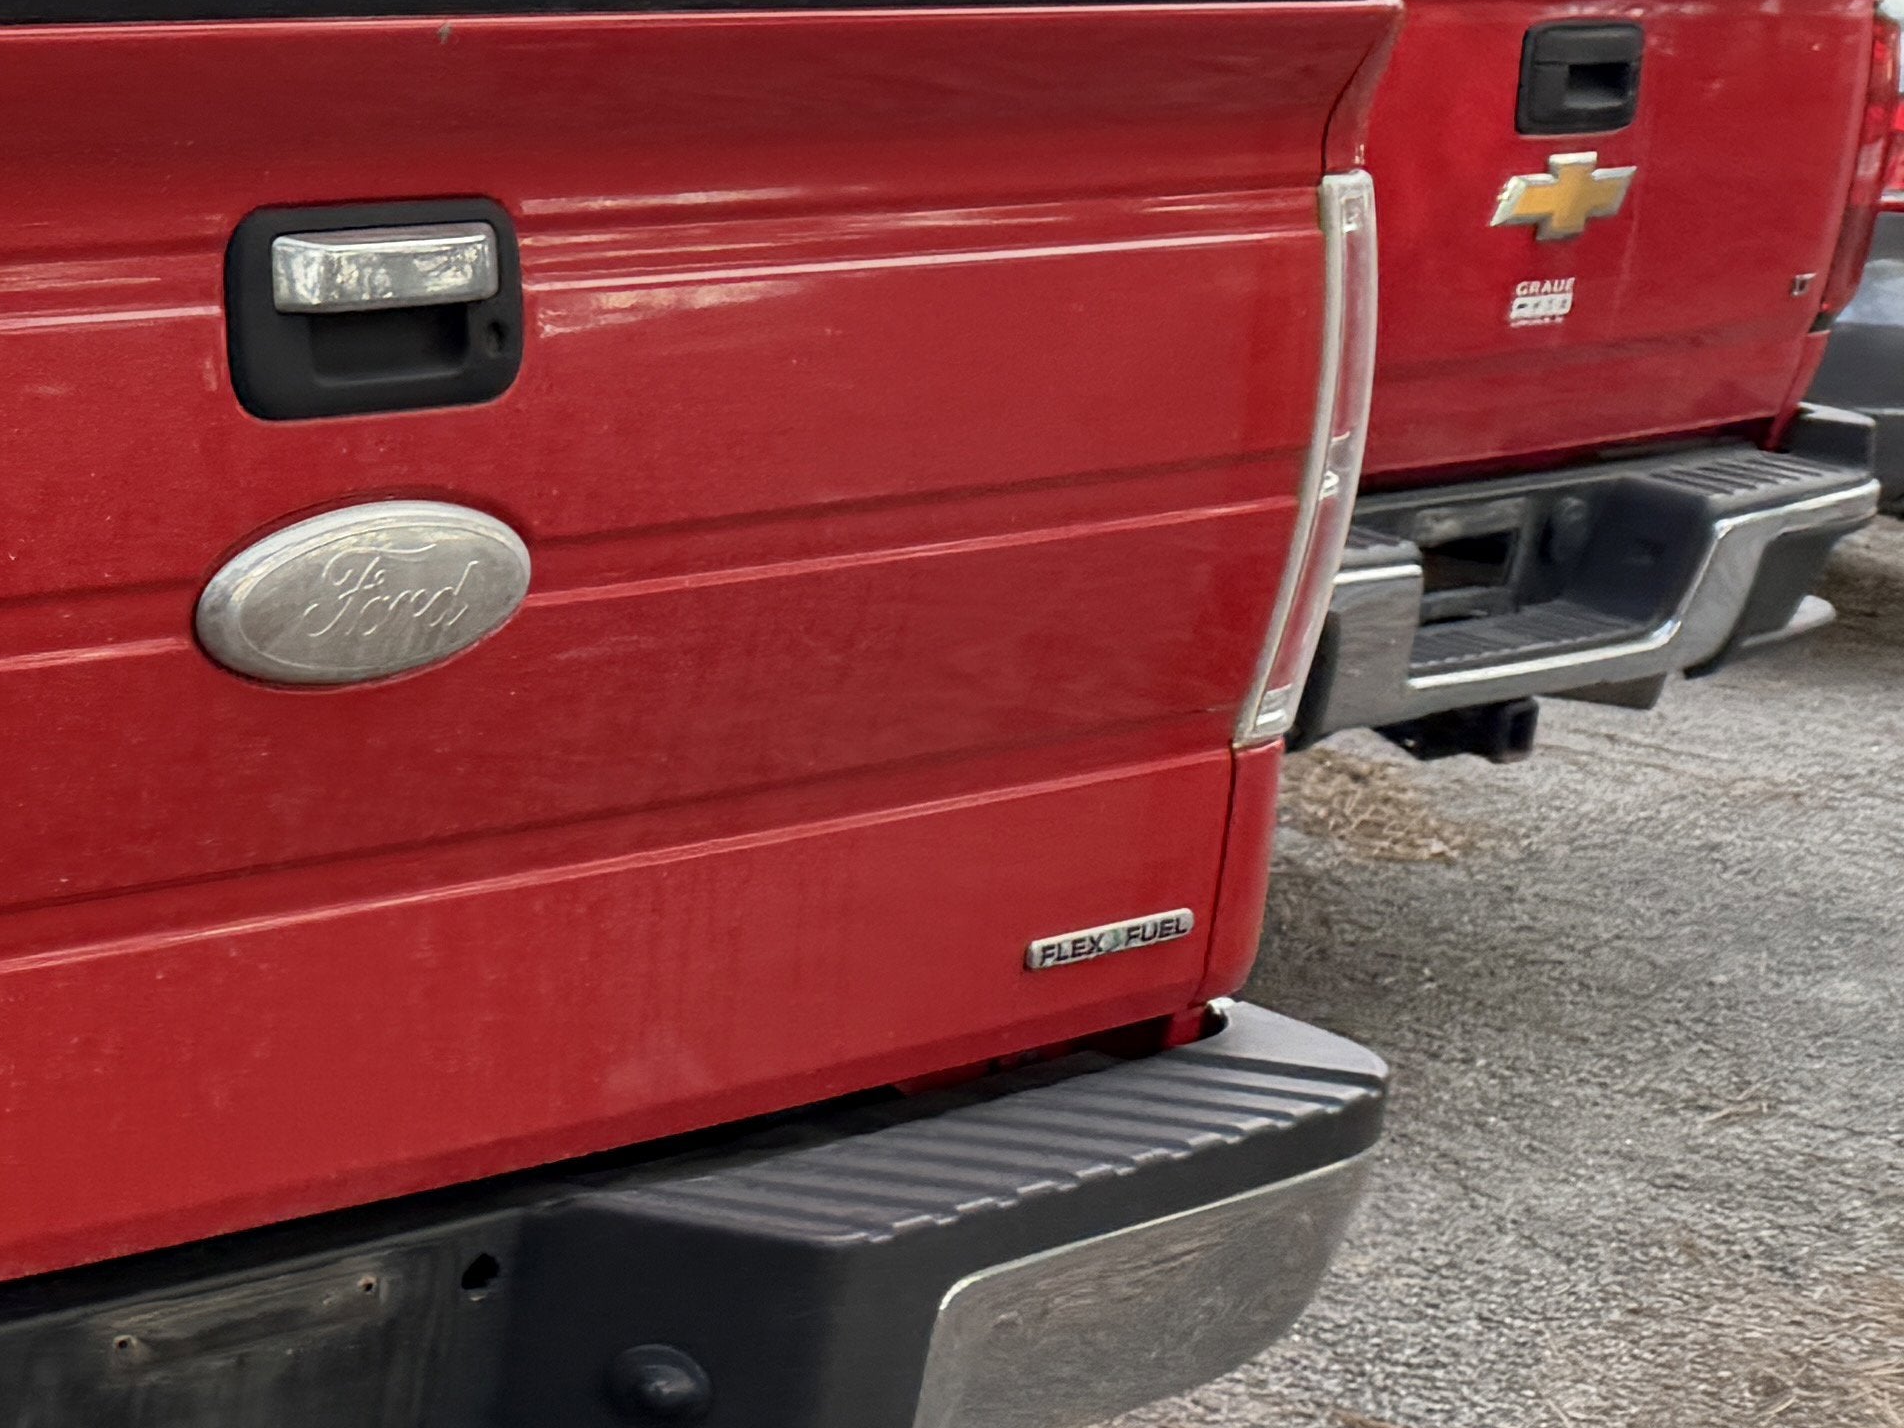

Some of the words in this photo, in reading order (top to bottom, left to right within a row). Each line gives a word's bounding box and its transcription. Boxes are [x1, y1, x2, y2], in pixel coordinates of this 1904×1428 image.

[302, 543, 480, 639] Ford
[1040, 934, 1104, 966] FLEX
[1125, 917, 1187, 946] FUEL
